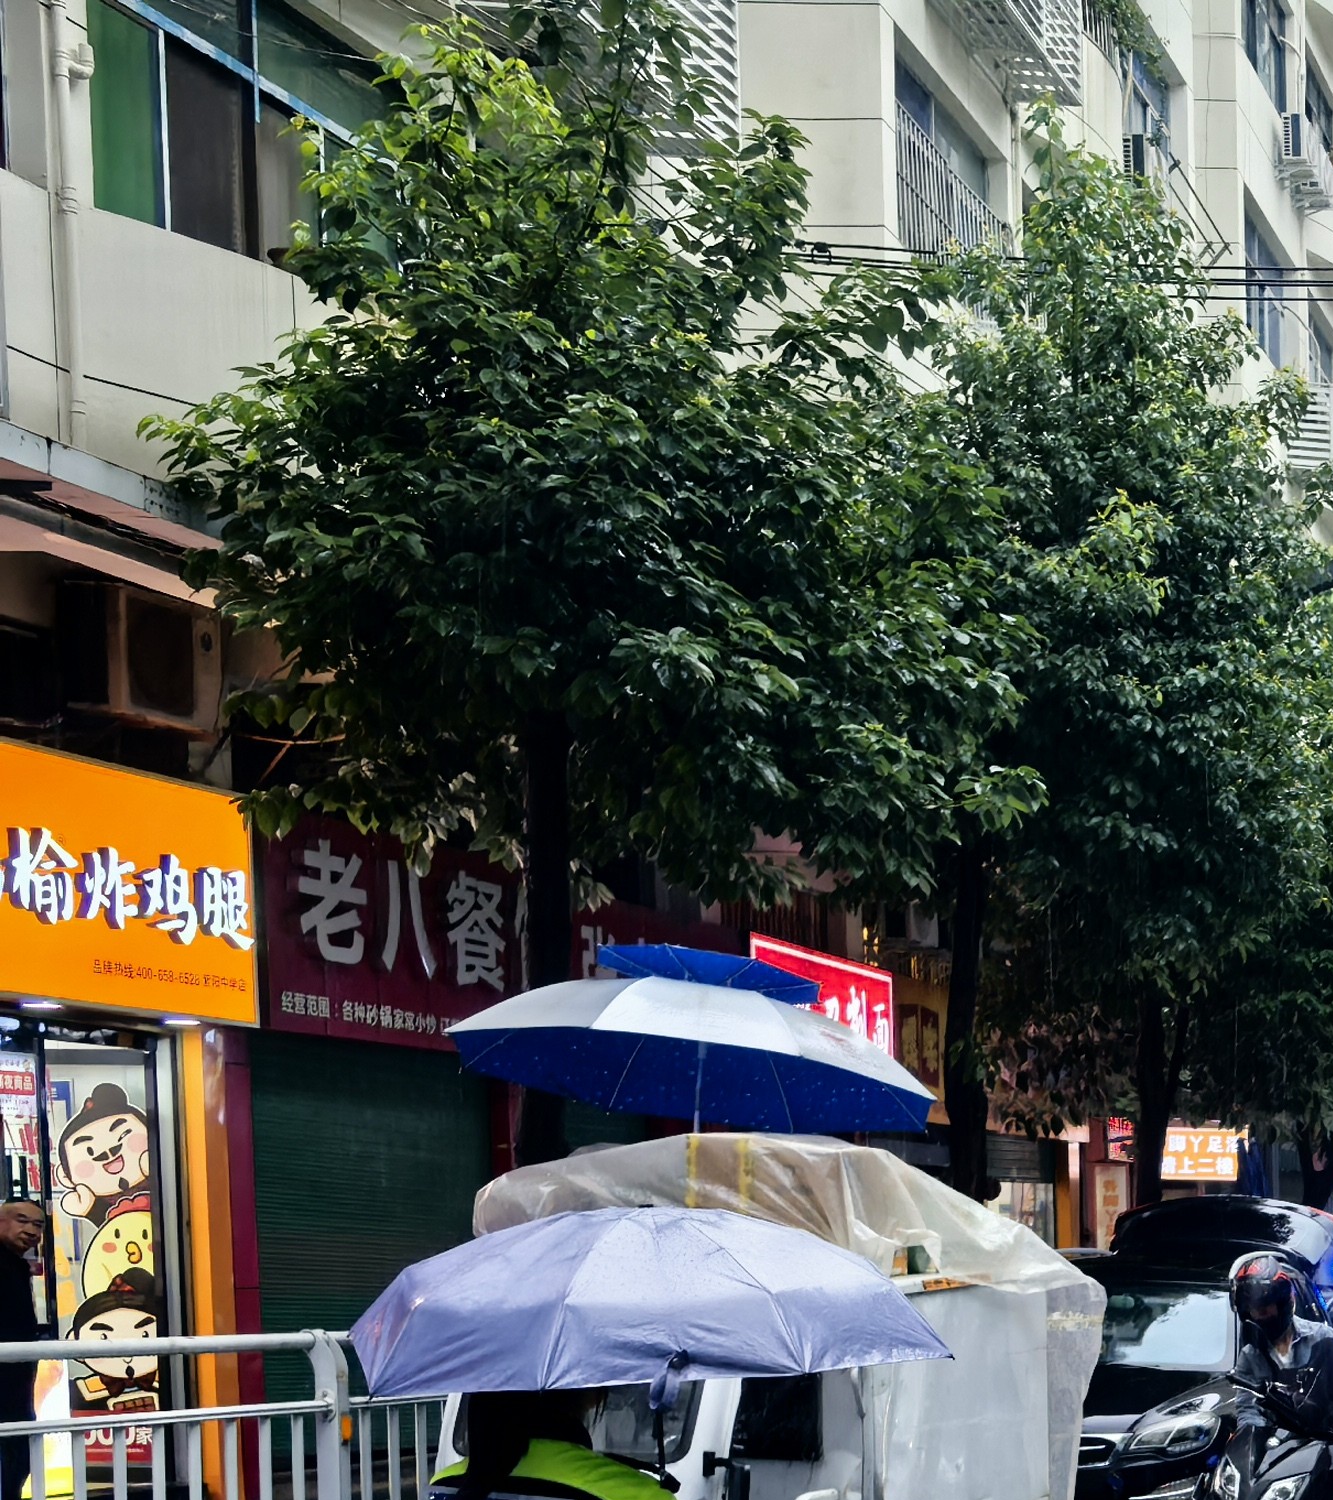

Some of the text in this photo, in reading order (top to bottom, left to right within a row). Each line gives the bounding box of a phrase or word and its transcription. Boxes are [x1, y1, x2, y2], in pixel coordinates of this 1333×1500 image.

[0, 827, 255, 950] 榆炸鸡腿
[298, 838, 530, 992] 老八餐
